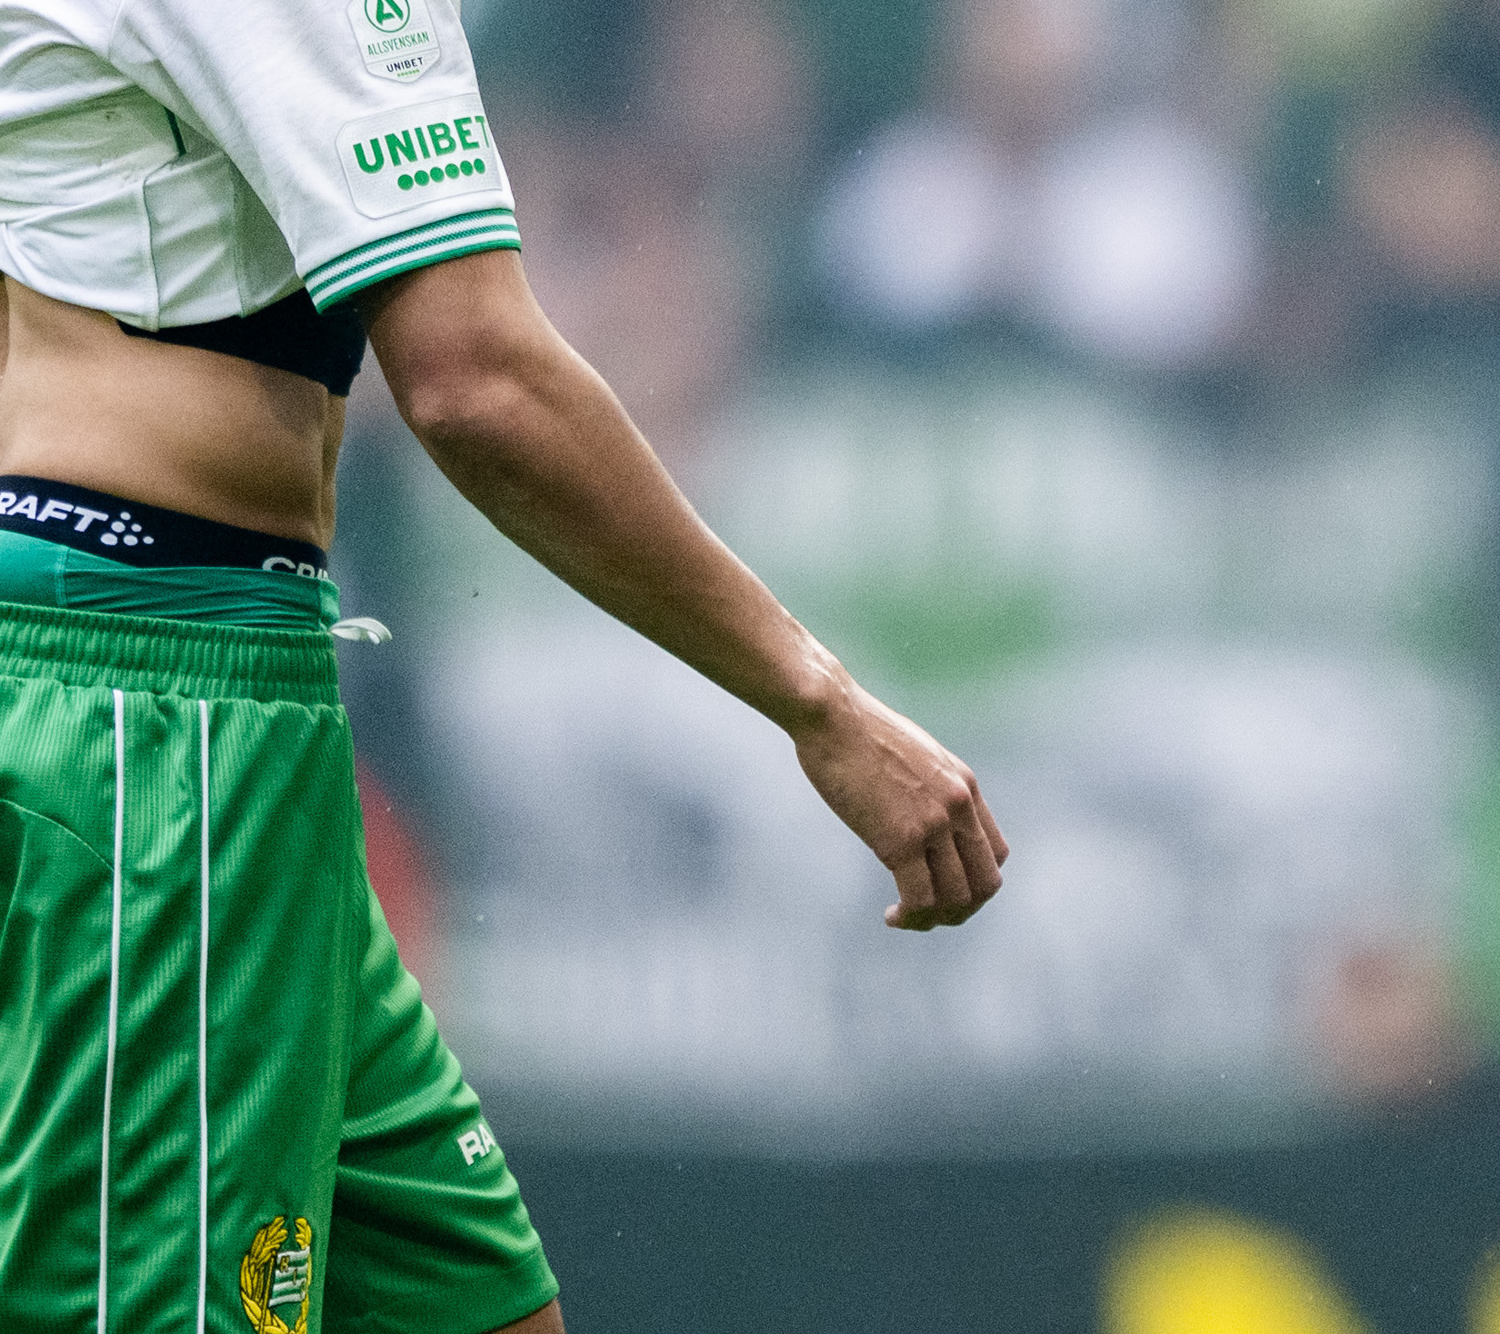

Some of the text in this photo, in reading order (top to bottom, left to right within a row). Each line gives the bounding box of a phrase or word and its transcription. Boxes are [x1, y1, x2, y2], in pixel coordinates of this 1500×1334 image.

[367, 31, 430, 55] ALLSVENSKAN
[386, 57, 424, 73] UNIBET
[353, 115, 490, 174] UNIBET
